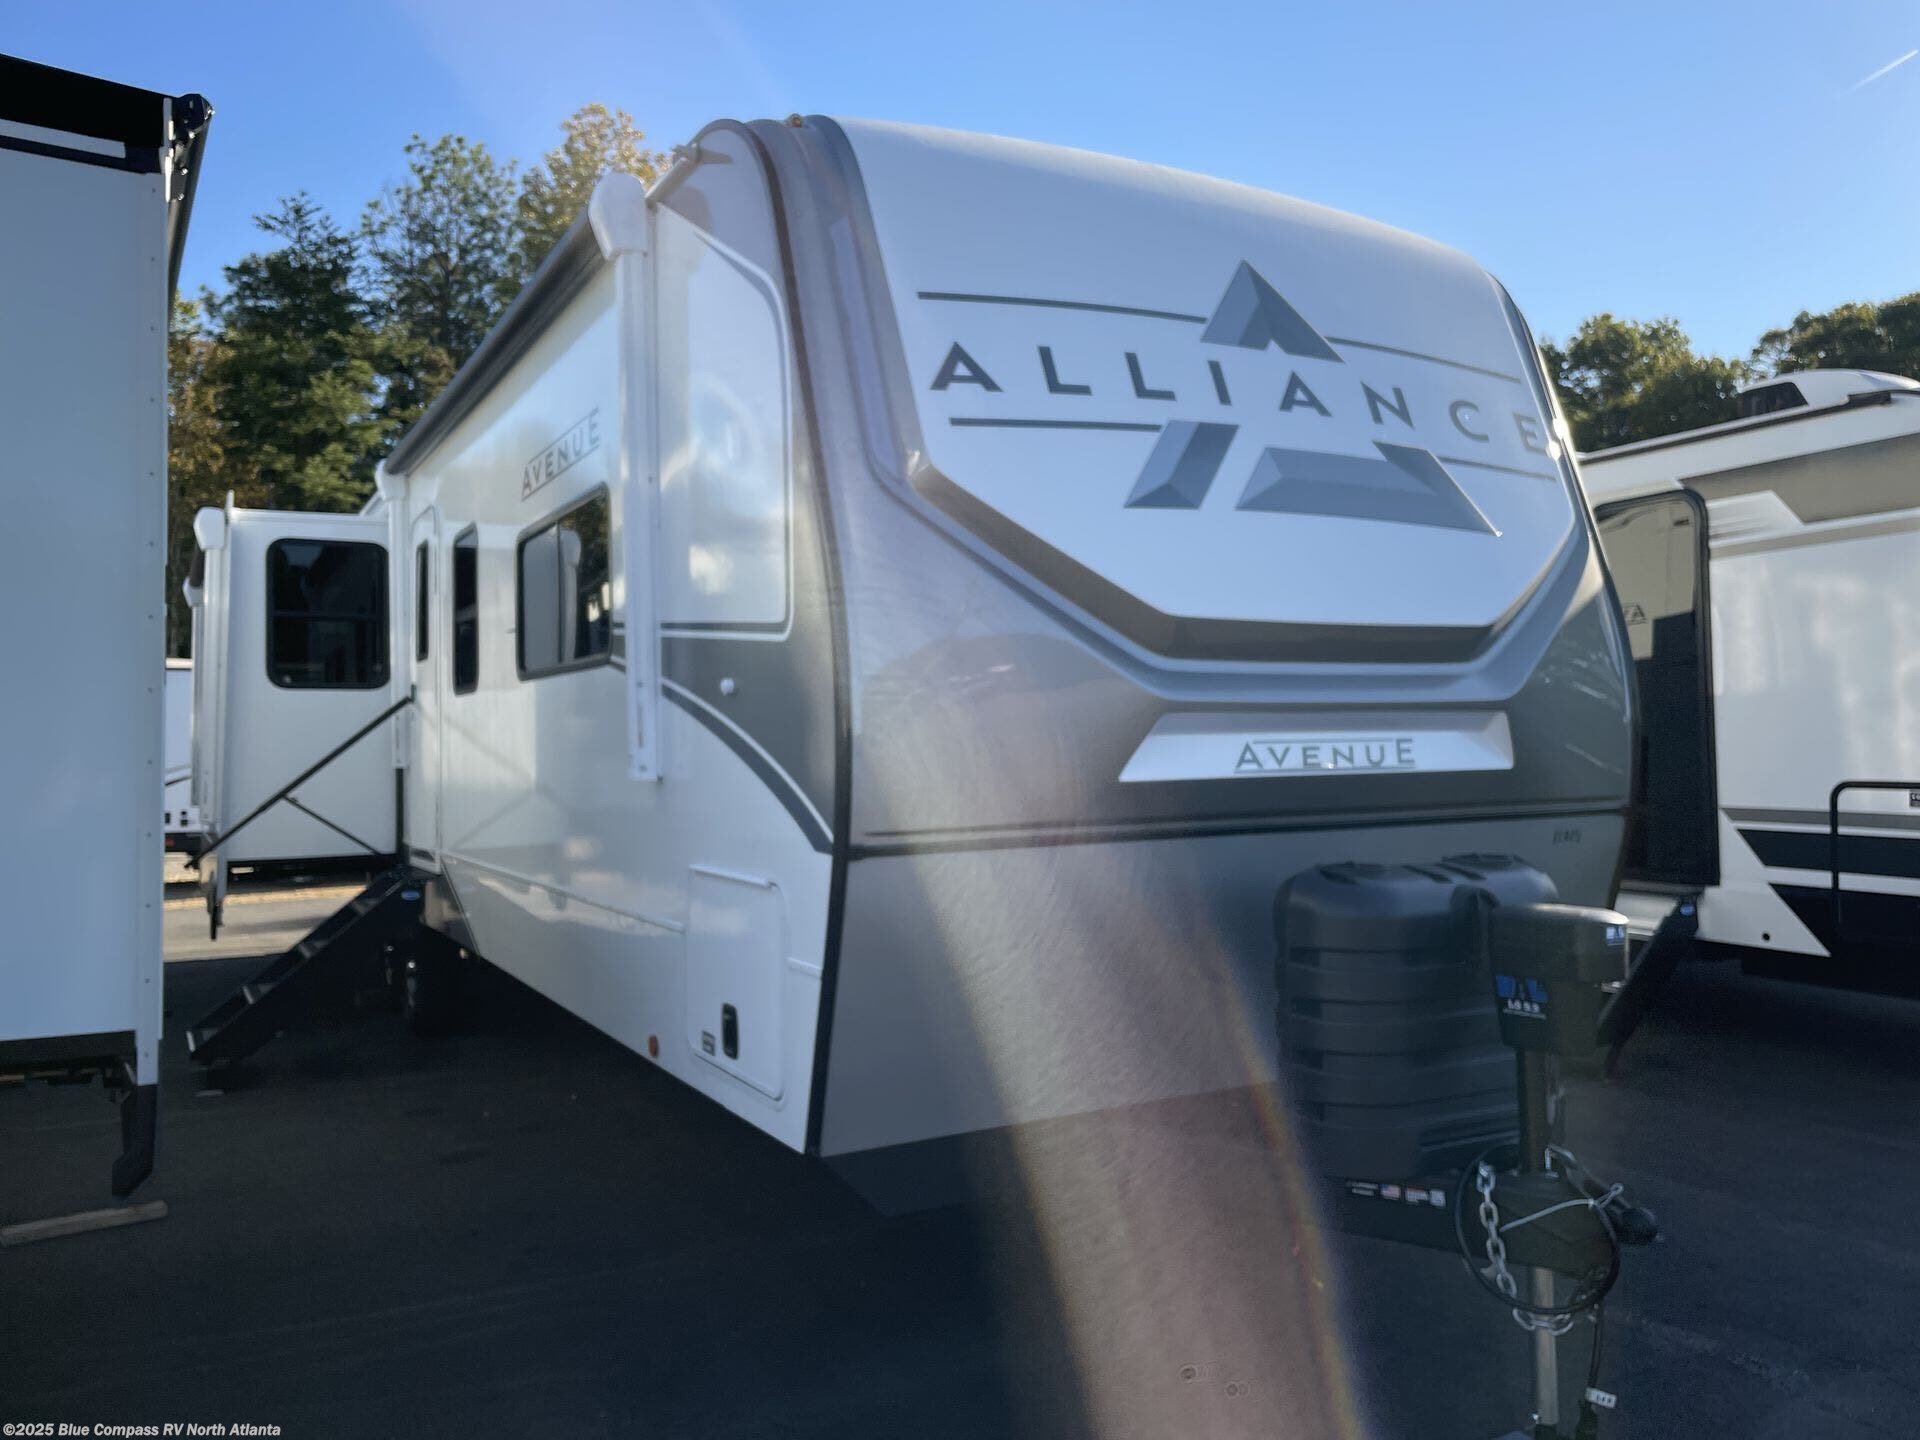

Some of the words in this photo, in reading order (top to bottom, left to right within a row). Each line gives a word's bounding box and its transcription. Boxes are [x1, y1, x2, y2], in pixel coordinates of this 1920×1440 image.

[930, 341, 1549, 456] ALLIANCE
[521, 406, 601, 500] AVENUE
[1235, 738, 1416, 769] AVENUE
